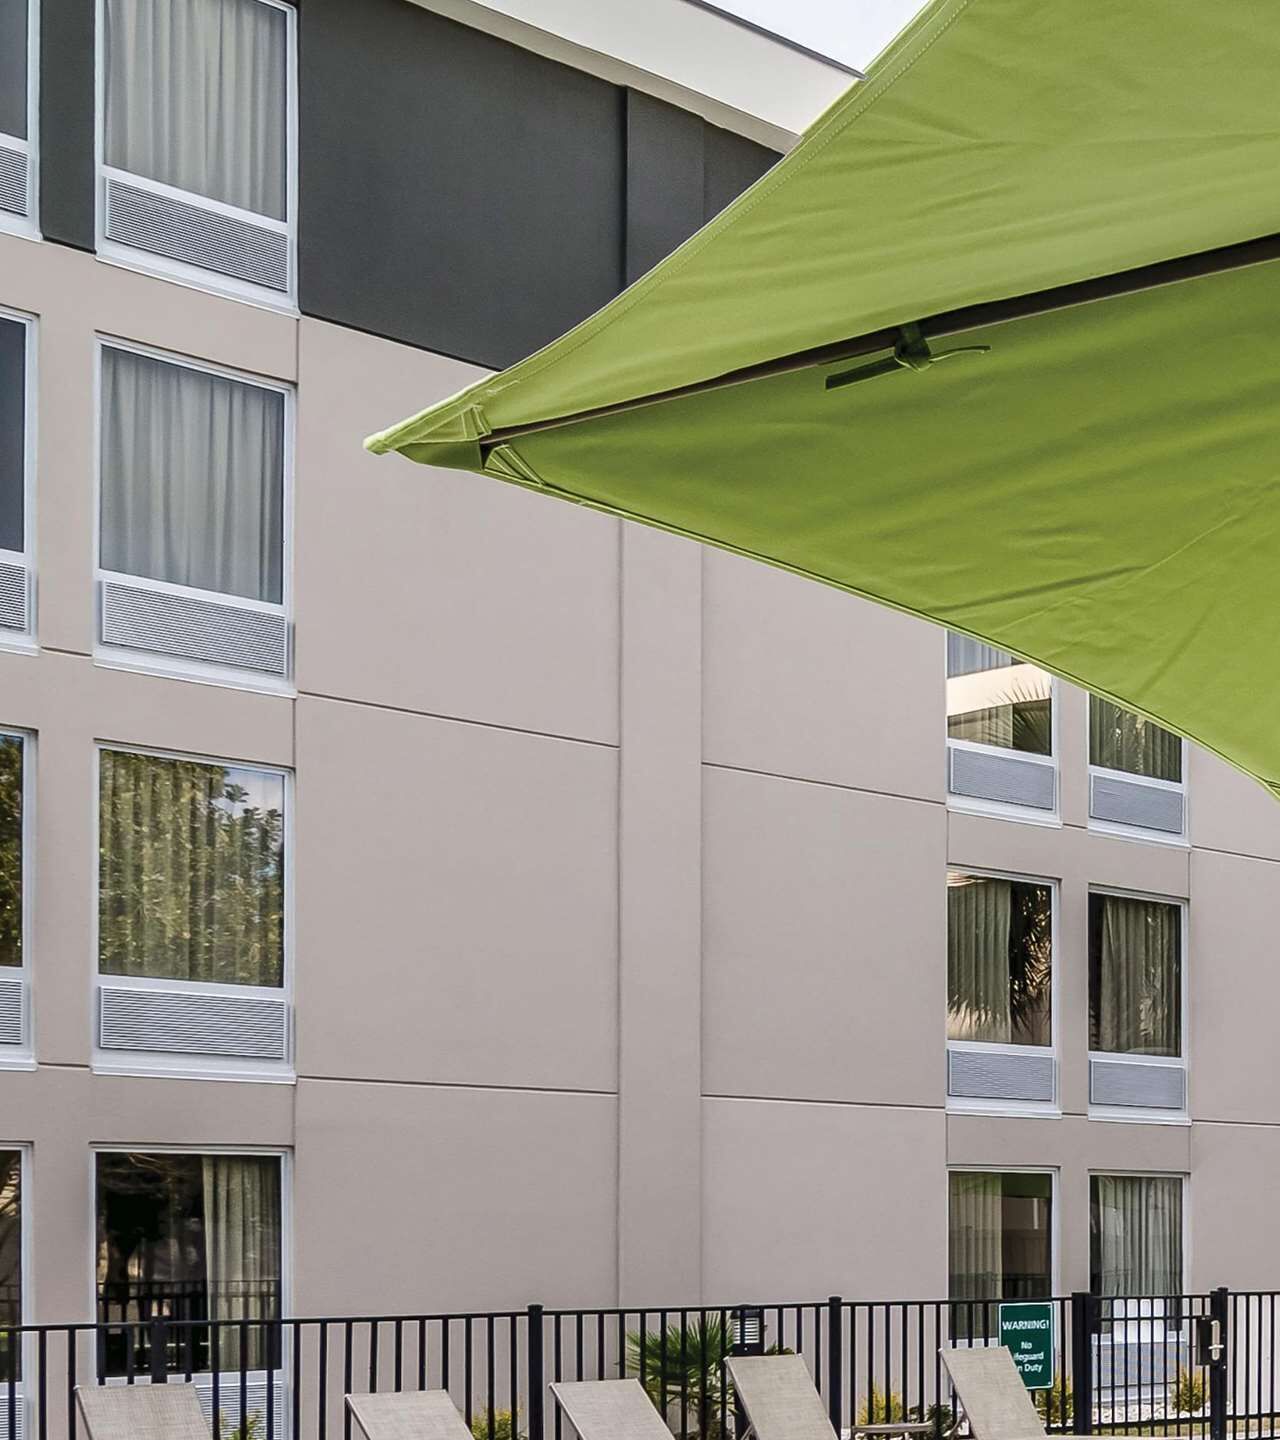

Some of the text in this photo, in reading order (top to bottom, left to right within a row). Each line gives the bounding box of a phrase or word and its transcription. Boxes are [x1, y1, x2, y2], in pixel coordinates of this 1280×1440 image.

[1001, 1319, 1050, 1331] WARNING!
[1020, 1341, 1033, 1350] No
[1024, 1363, 1044, 1373] Duty
